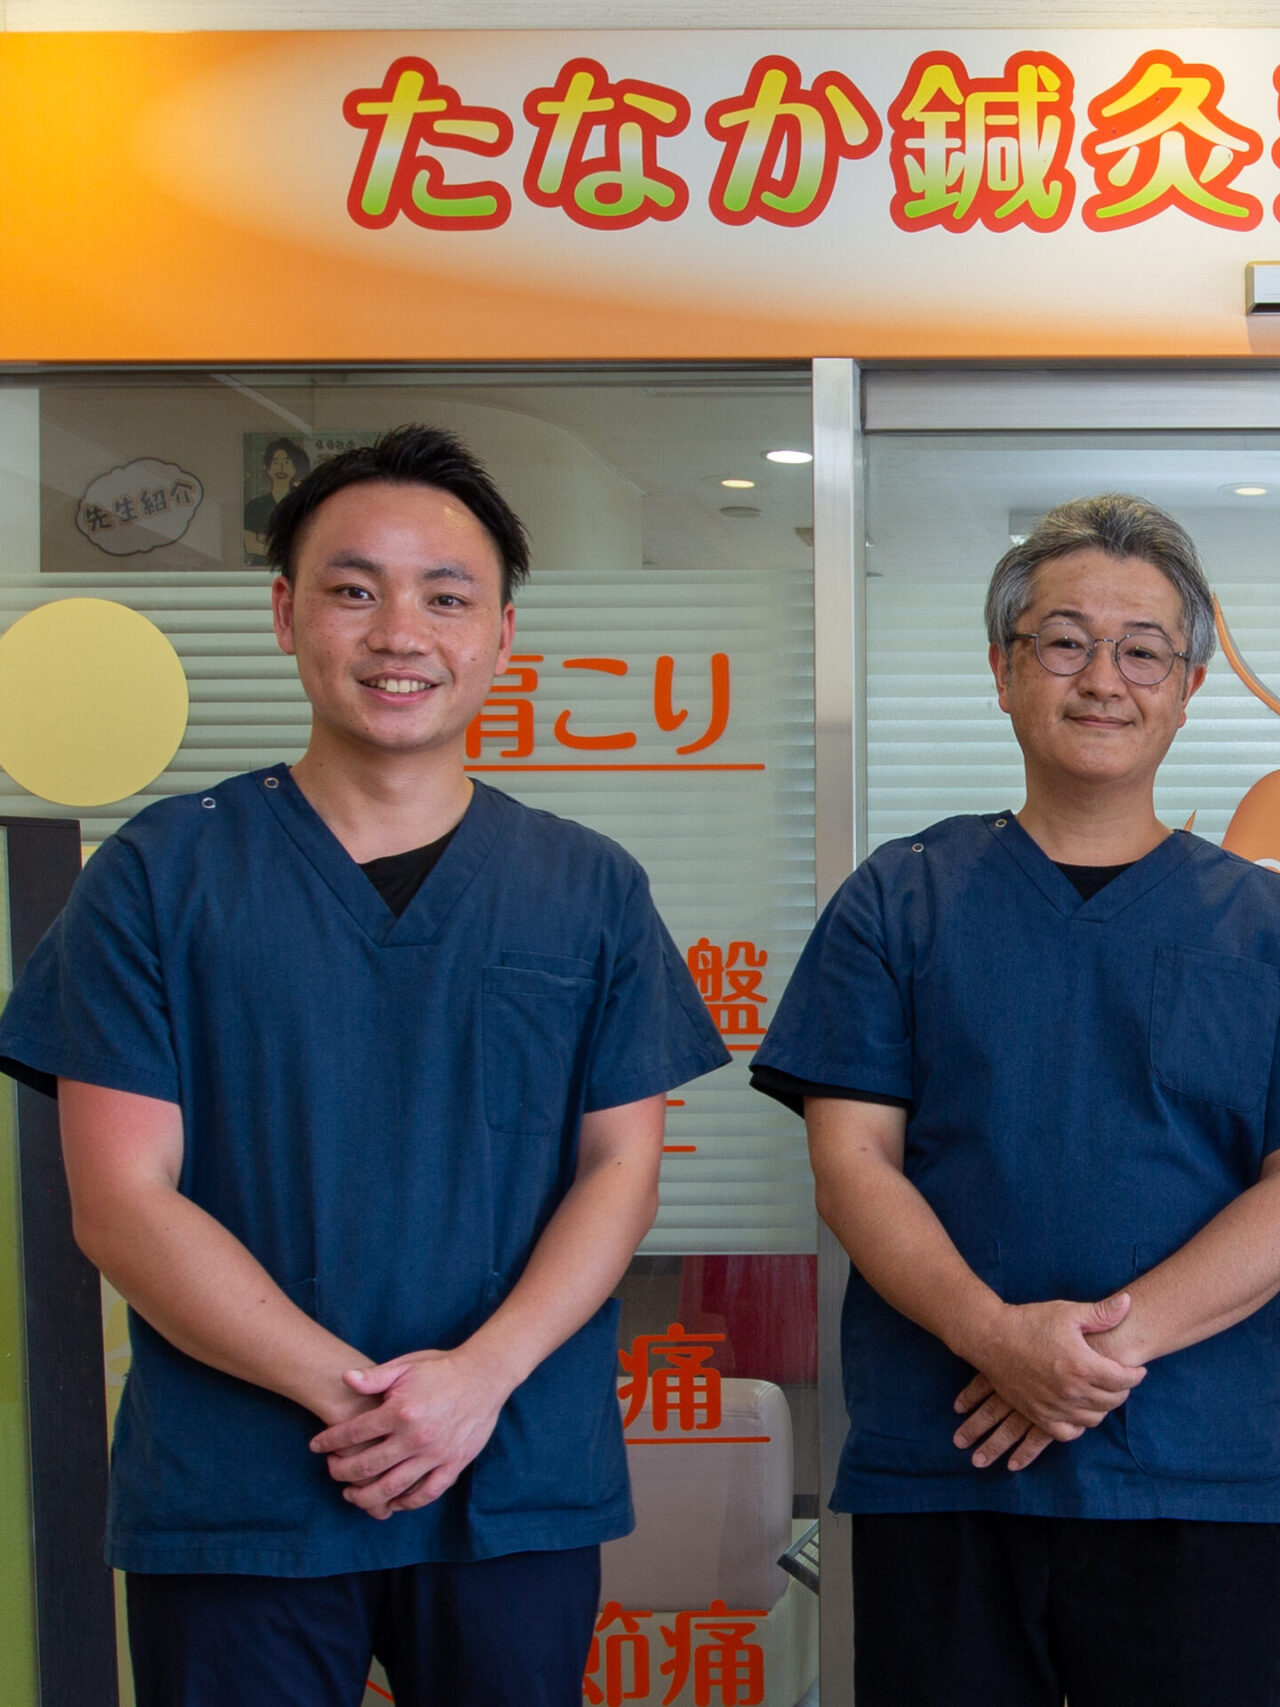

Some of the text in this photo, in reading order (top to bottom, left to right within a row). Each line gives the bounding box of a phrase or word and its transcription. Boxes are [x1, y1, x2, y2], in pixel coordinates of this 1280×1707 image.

[86, 480, 193, 533] 先生紹介
[465, 653, 729, 760] 肩こり
[617, 1322, 726, 1432] 痛
